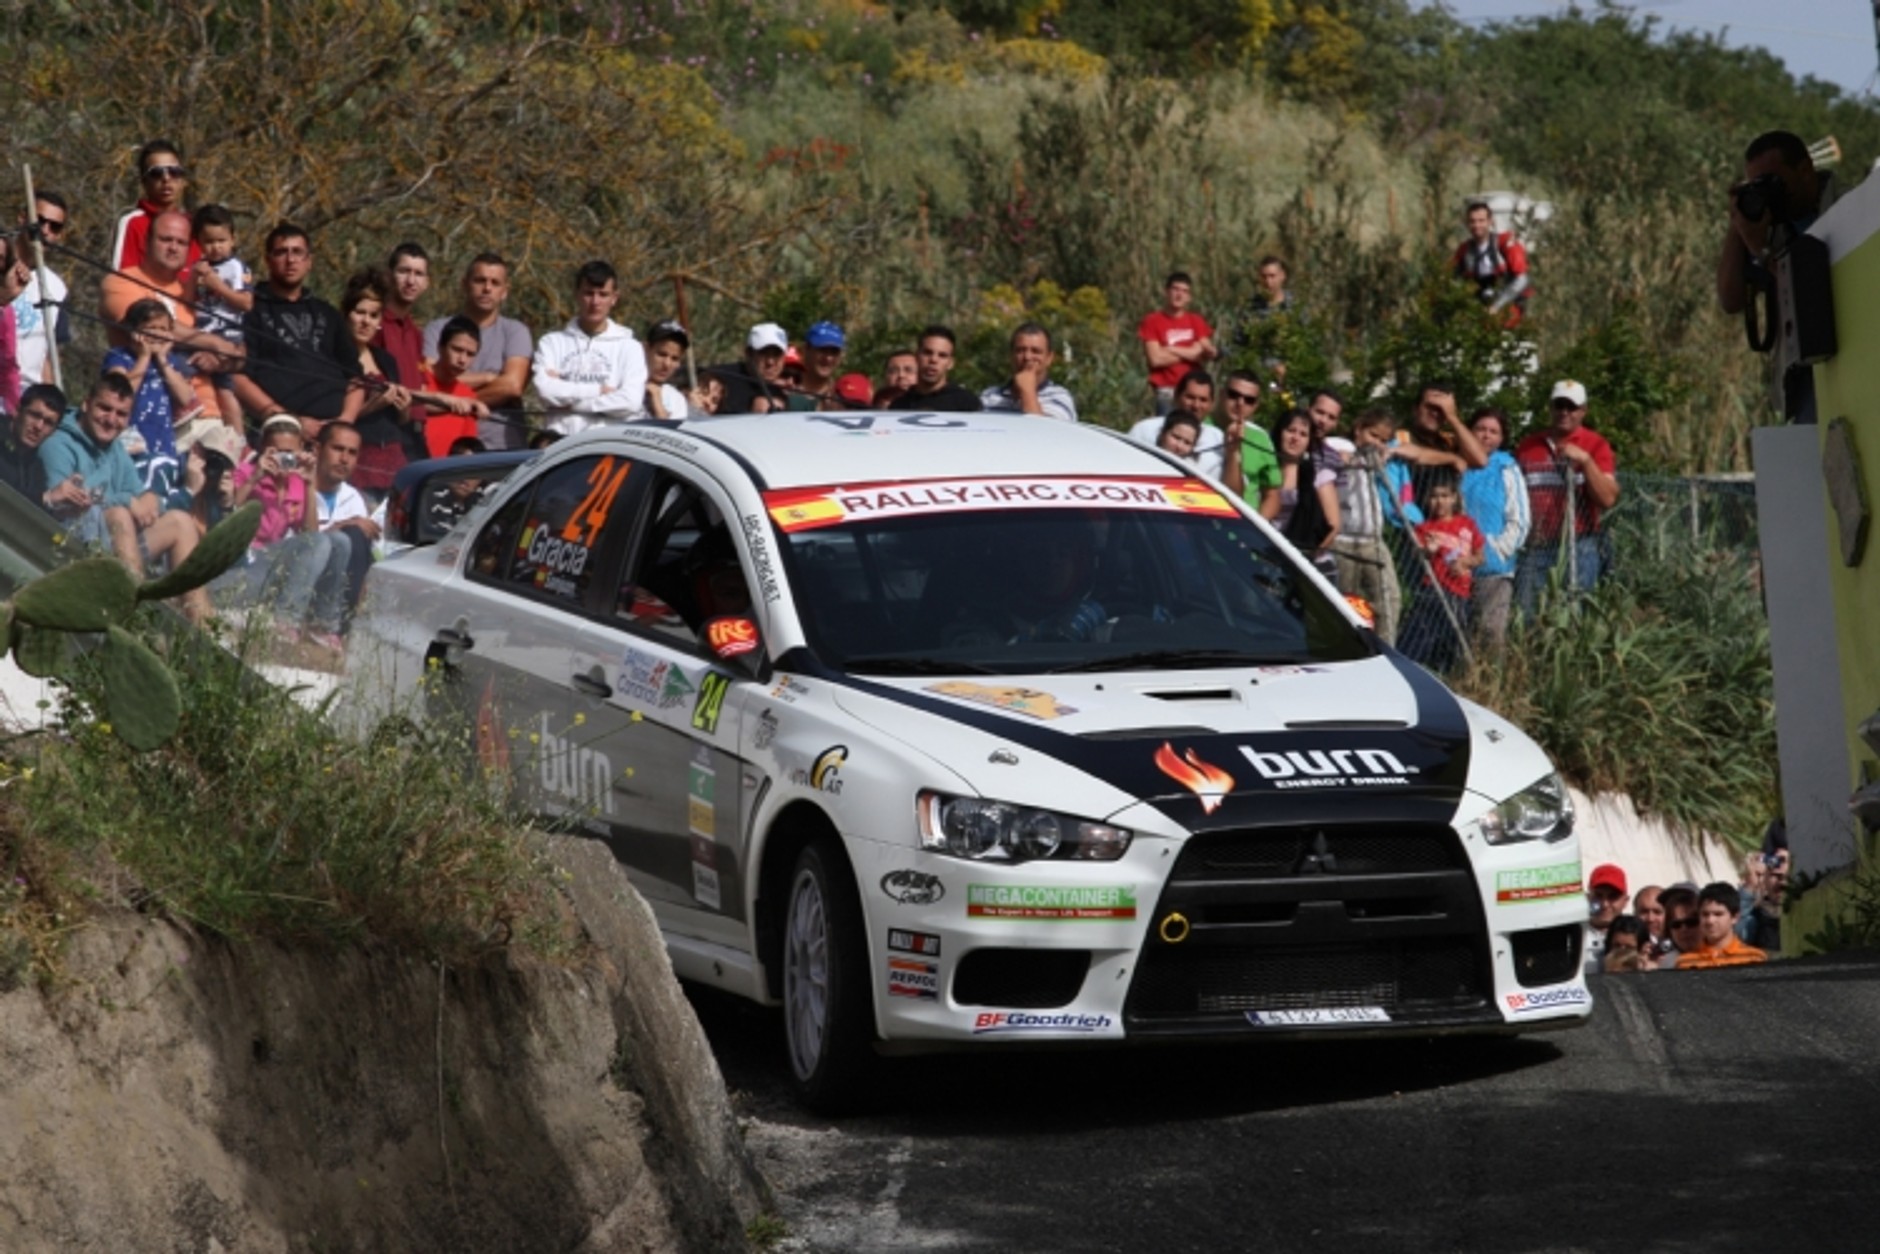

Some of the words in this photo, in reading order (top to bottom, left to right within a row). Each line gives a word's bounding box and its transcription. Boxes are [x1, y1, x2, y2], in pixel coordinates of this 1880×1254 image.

[562, 454, 632, 548] 24
[839, 484, 1168, 512] RALLY-IRC.COM
[528, 523, 588, 576] Gracia
[692, 669, 730, 736] 24
[1237, 745, 1408, 779] burn
[971, 886, 1120, 907] MEGACONTAINER
[975, 1012, 1112, 1028] BFGoodrich
